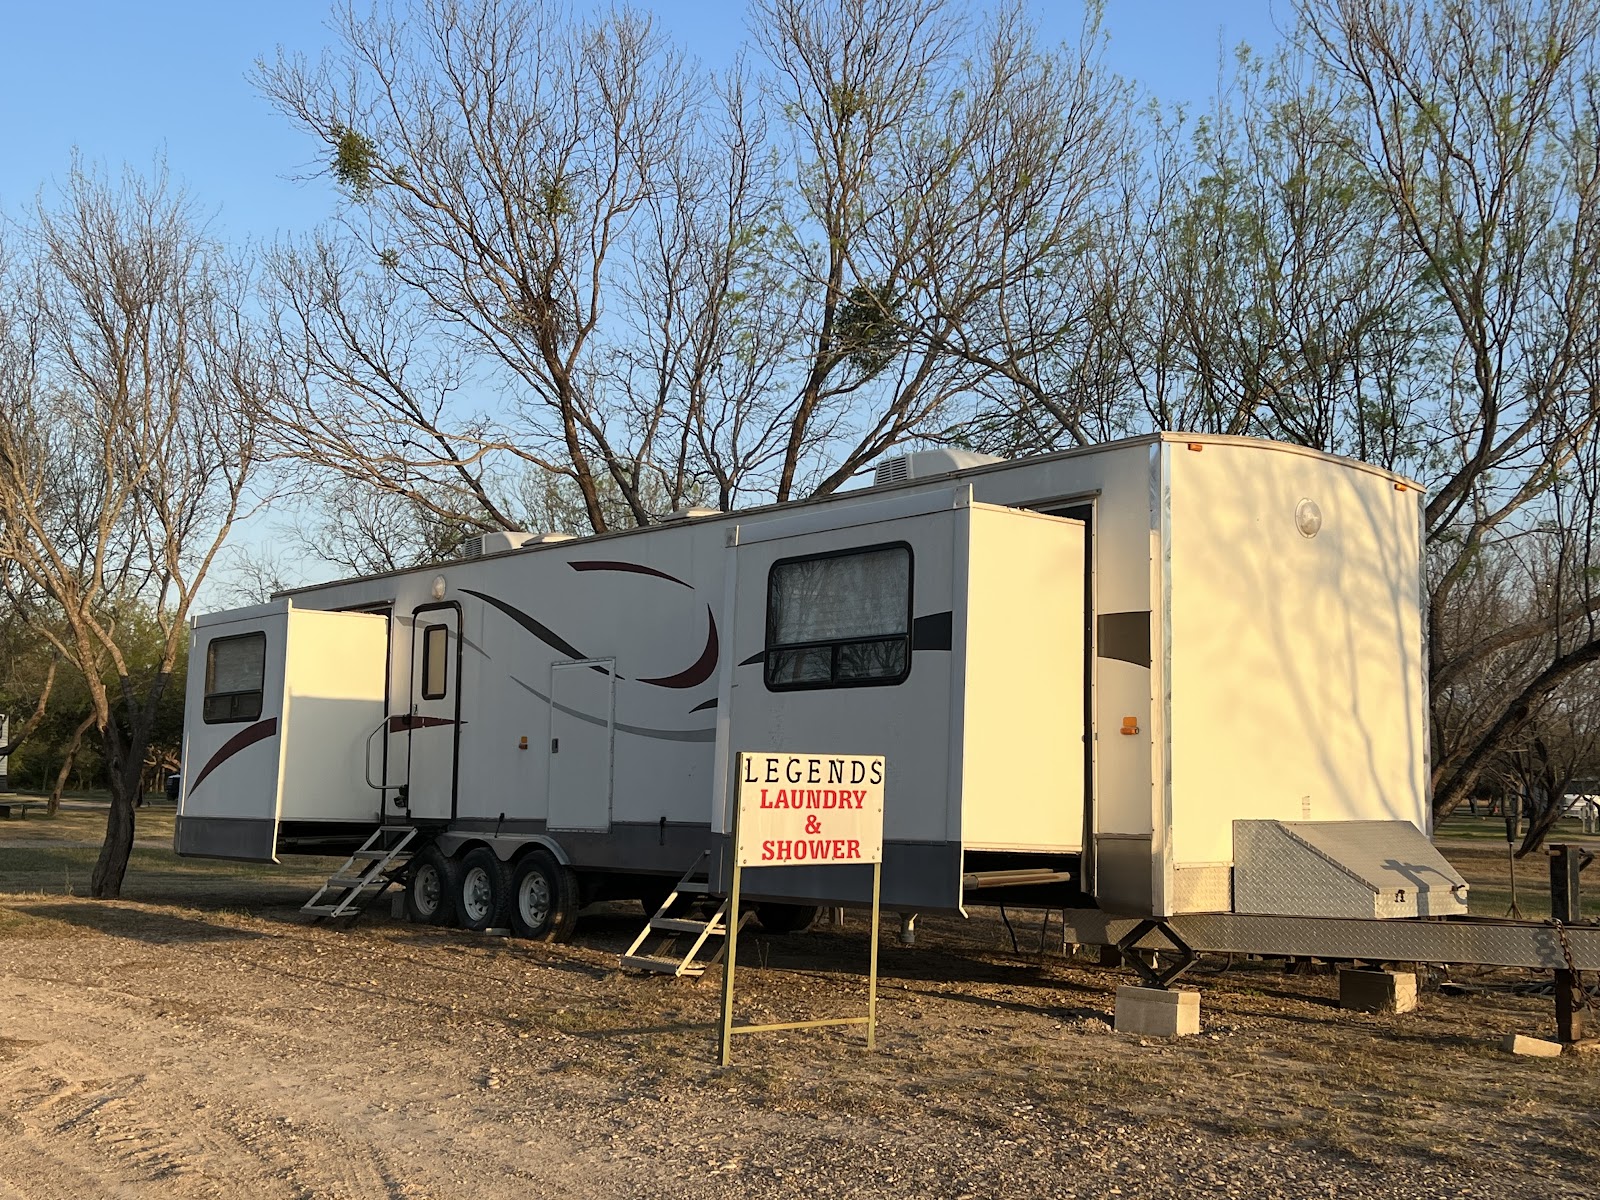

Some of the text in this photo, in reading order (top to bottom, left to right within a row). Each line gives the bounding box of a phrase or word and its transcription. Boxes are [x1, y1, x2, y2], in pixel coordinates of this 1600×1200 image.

[745, 758, 882, 784] LEGENDS
[760, 789, 867, 809] LAUNDRY
[805, 815, 821, 834] &
[762, 840, 861, 860] SHOWER
